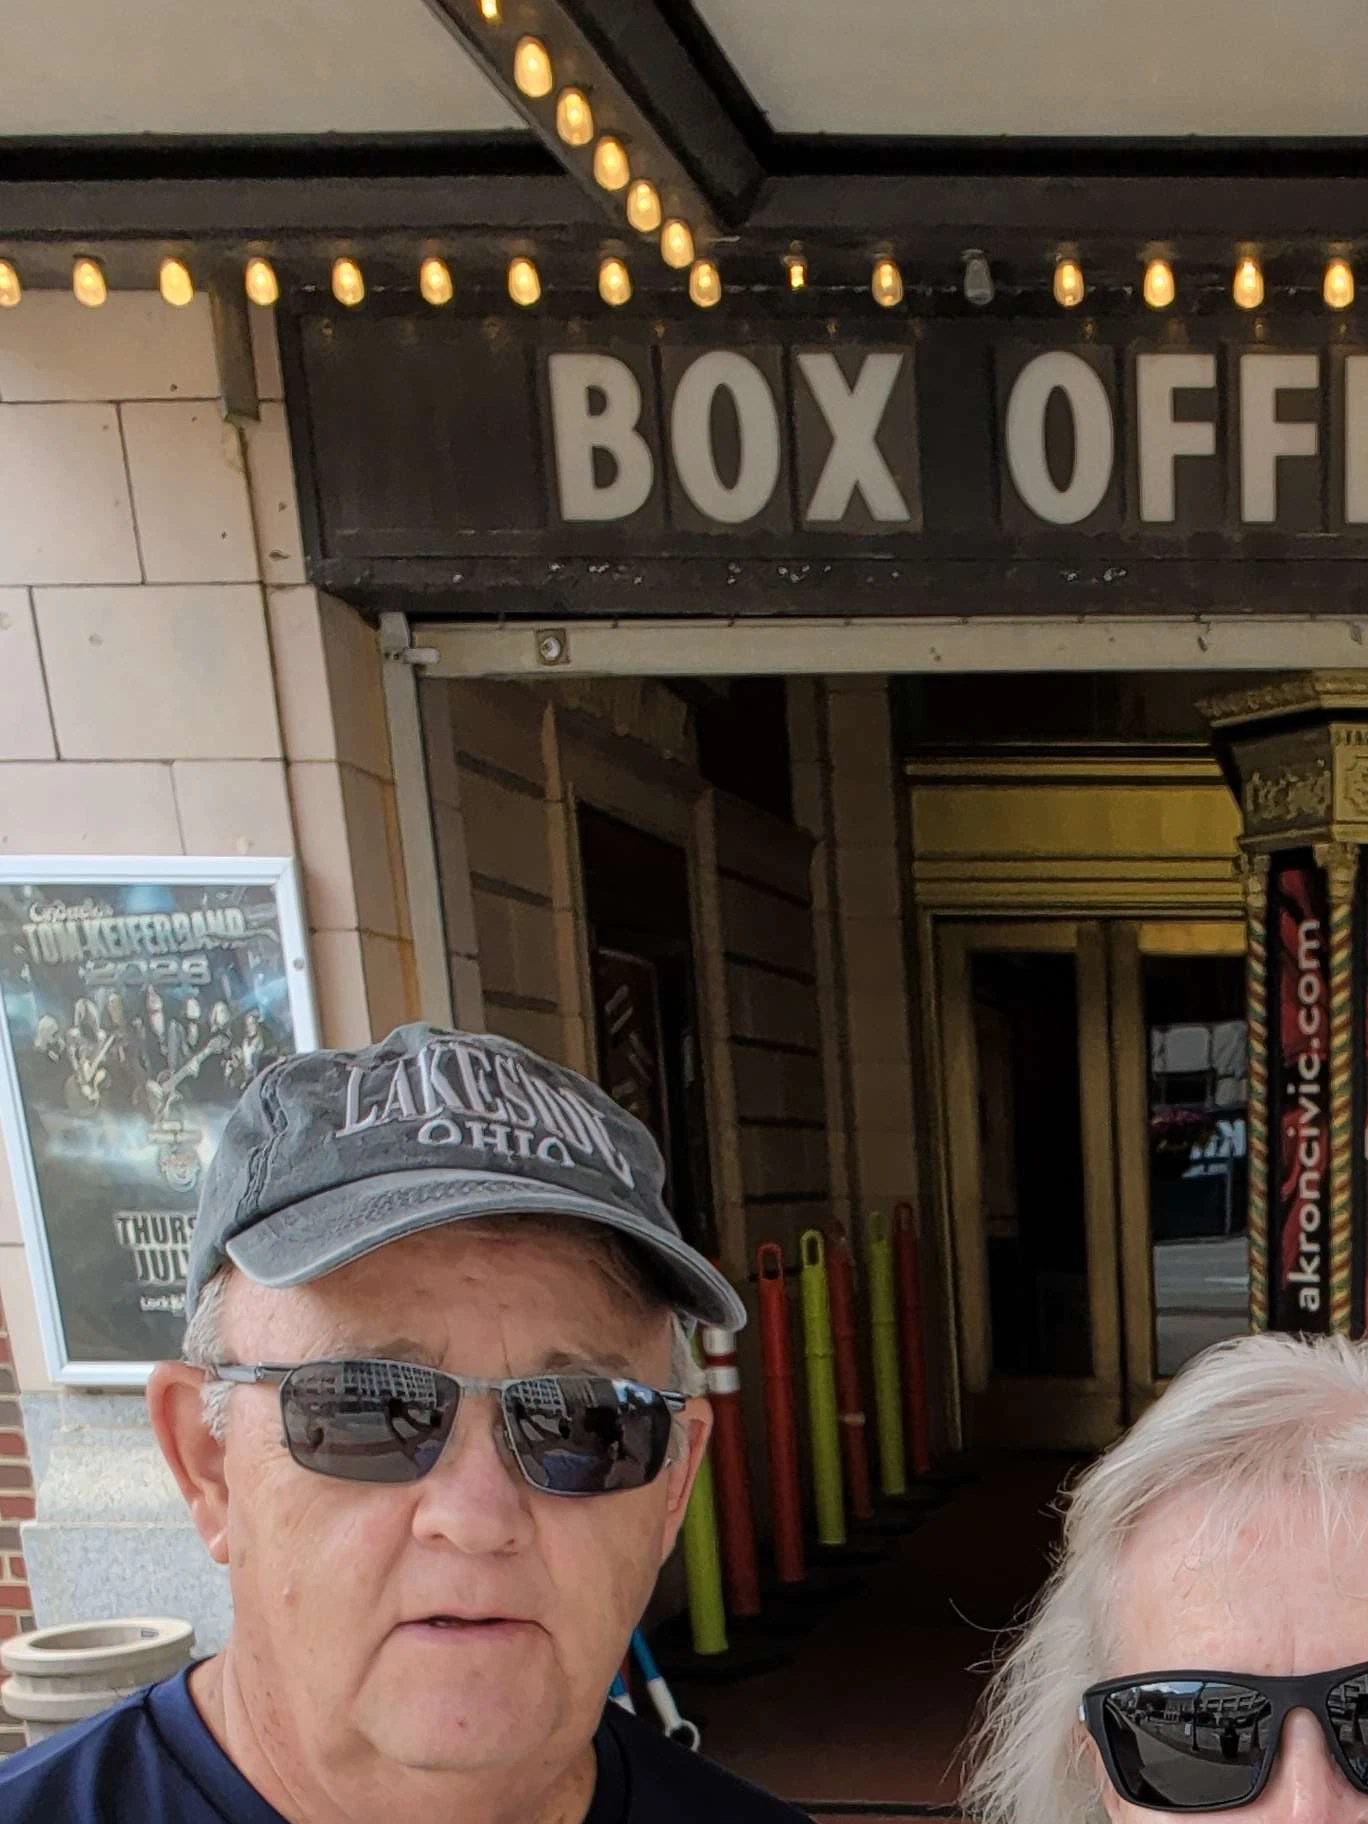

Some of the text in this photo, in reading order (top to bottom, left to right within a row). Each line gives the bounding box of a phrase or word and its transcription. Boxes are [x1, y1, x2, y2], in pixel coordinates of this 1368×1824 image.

[547, 352, 911, 524] BOX
[336, 1041, 636, 1190] LAKESIDE
[417, 1117, 577, 1168] OHIO
[1287, 918, 1321, 1313] akroncivic.com
